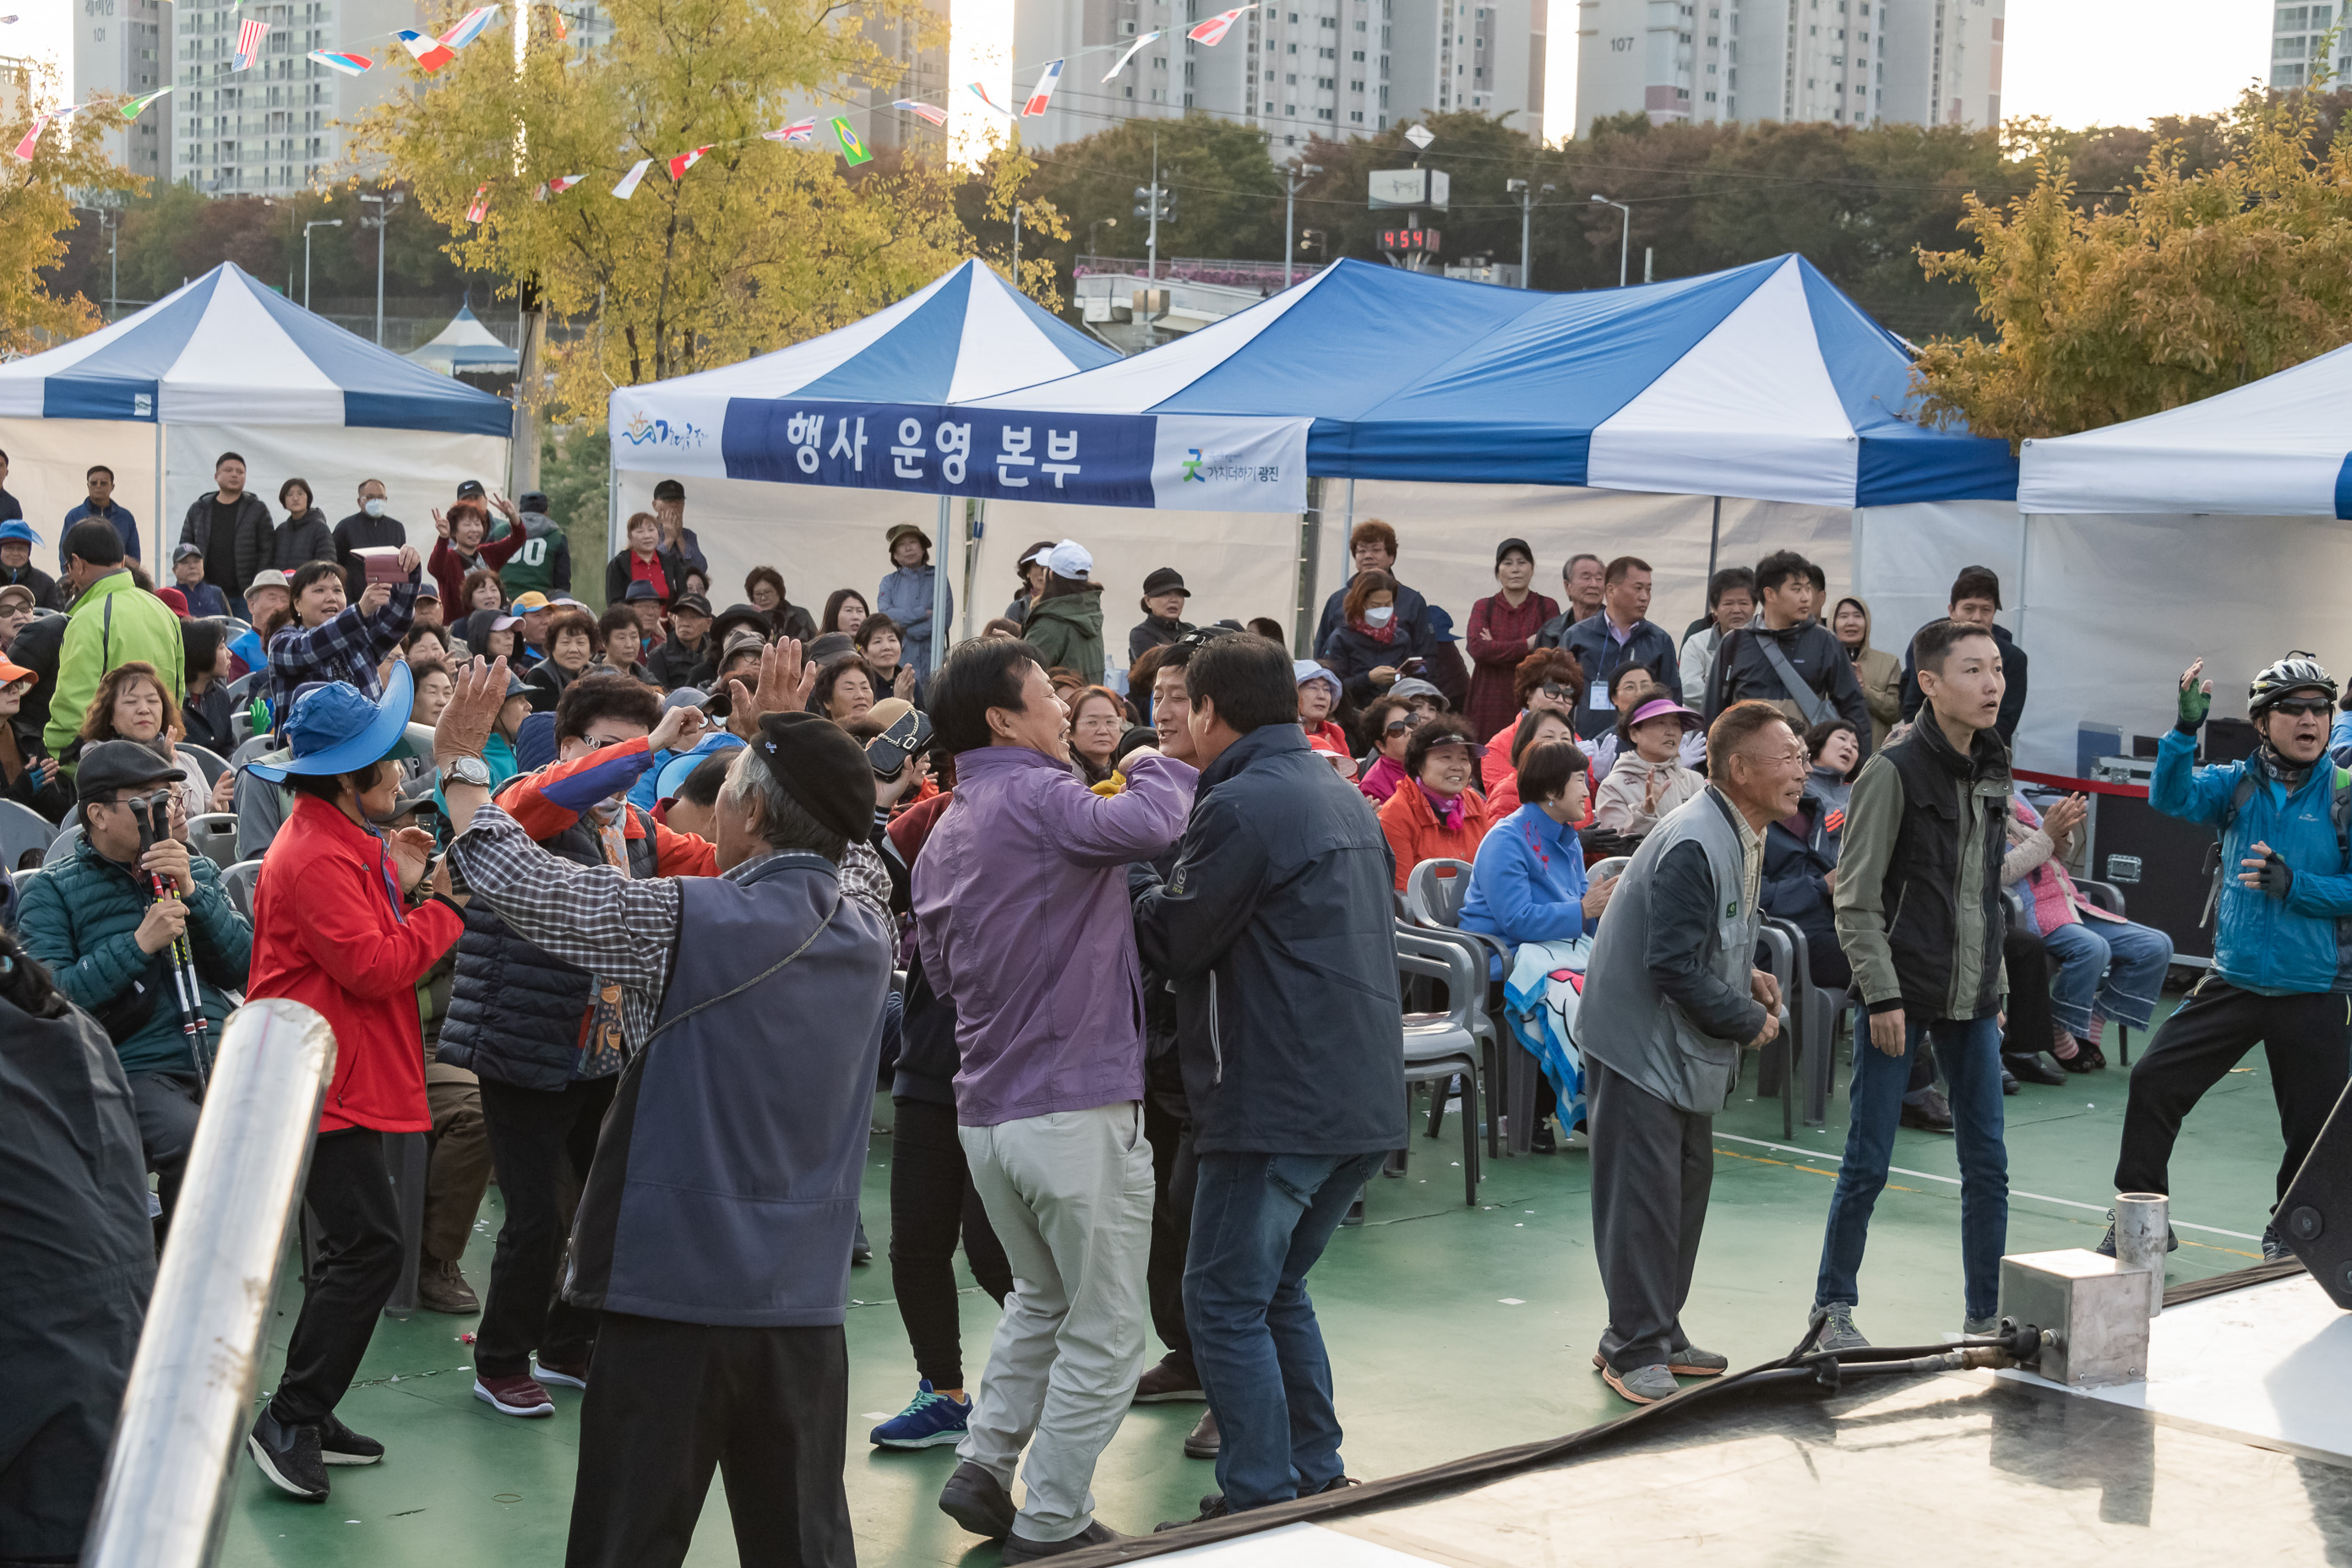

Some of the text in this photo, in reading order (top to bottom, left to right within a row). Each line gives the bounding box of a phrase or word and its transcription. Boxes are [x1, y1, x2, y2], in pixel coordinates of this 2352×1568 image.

[93, 27, 106, 42] 101
[1610, 37, 1635, 52] 107
[787, 411, 1081, 488] 행사 운영 본부
[1207, 466, 1279, 482] 가치더하기 광진
